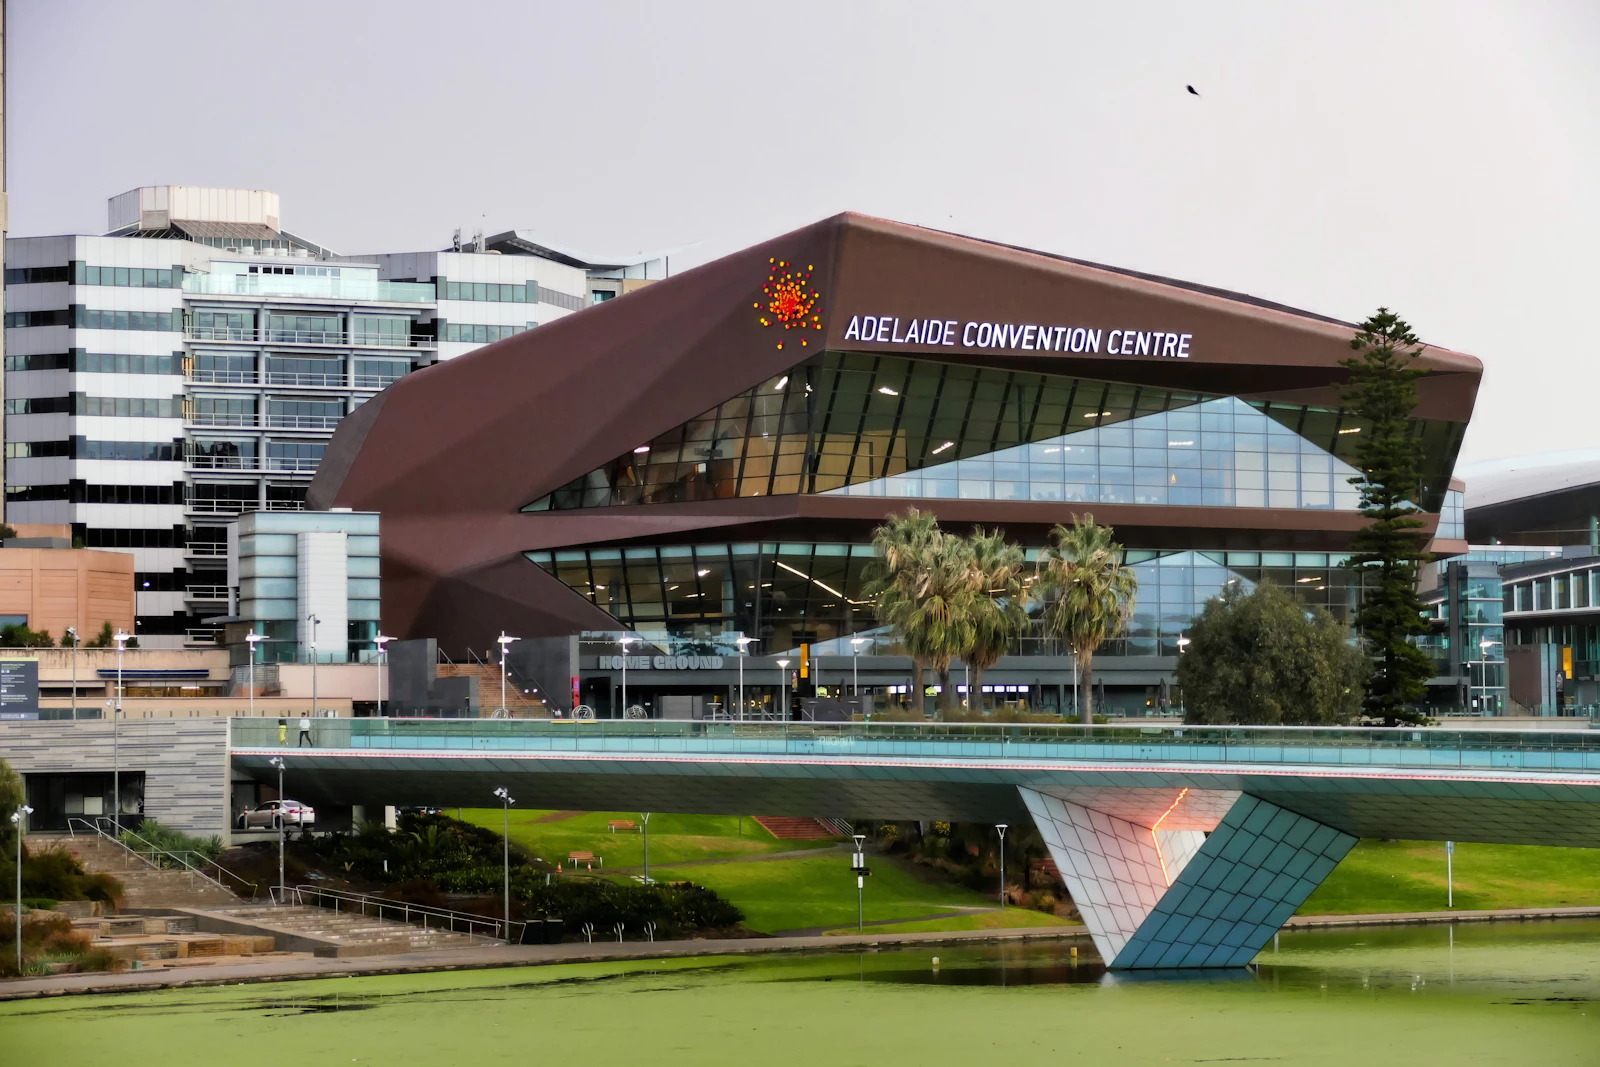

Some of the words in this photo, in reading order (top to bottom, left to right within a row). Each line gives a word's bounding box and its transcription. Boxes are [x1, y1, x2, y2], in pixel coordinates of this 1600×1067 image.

[844, 315, 958, 346] ADELAIDE
[962, 321, 1102, 353] CONVENTION
[1107, 330, 1193, 358] CENTRE
[599, 655, 650, 670] HOME
[653, 655, 724, 670] GROUND
